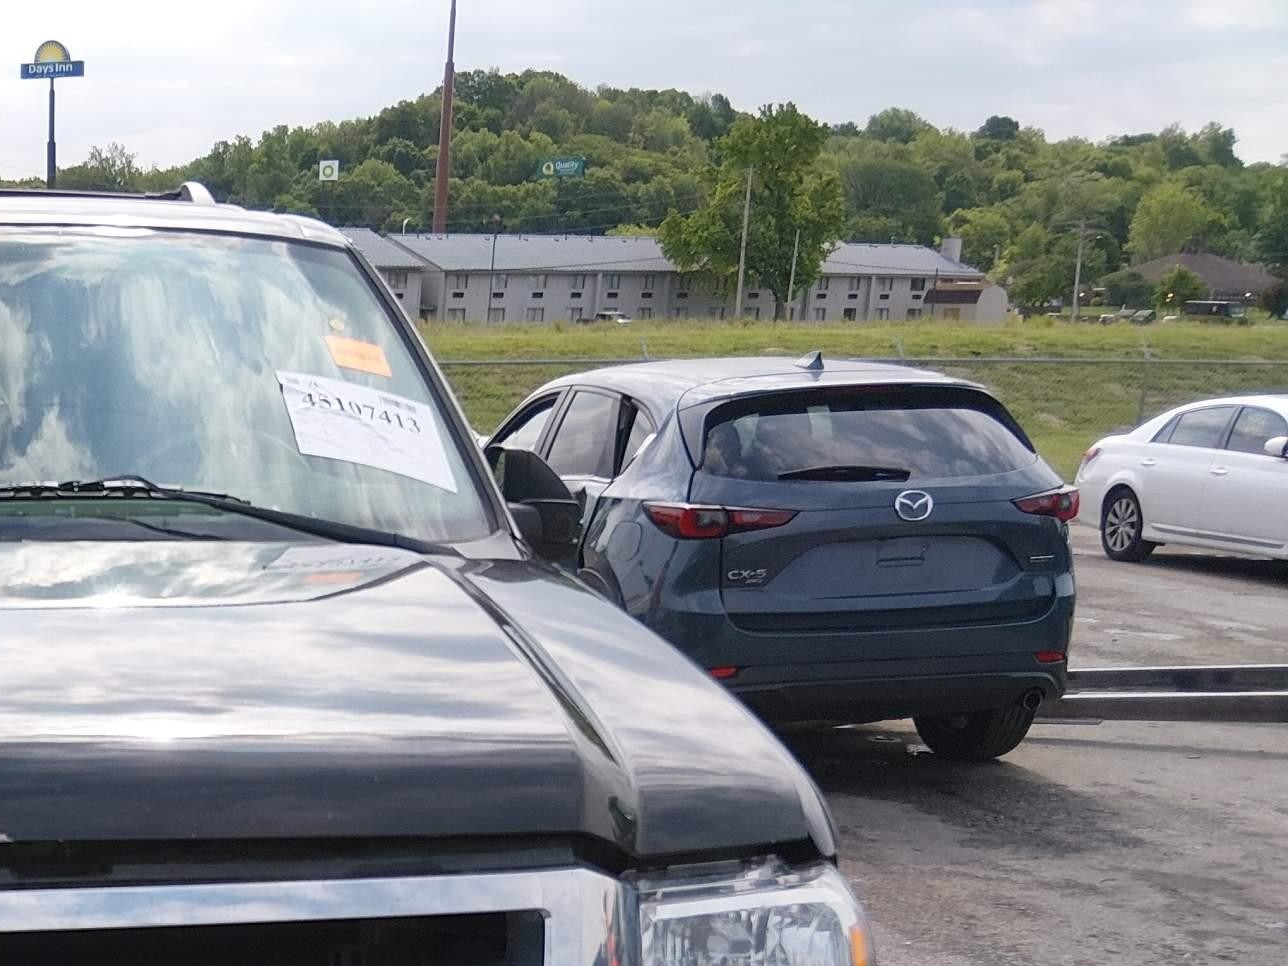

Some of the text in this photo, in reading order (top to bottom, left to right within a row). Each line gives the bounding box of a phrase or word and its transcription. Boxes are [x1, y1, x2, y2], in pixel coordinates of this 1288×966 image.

[28, 63, 73, 74] Days Inn
[301, 393, 421, 434] 45107413
[727, 568, 768, 580] CX-5
